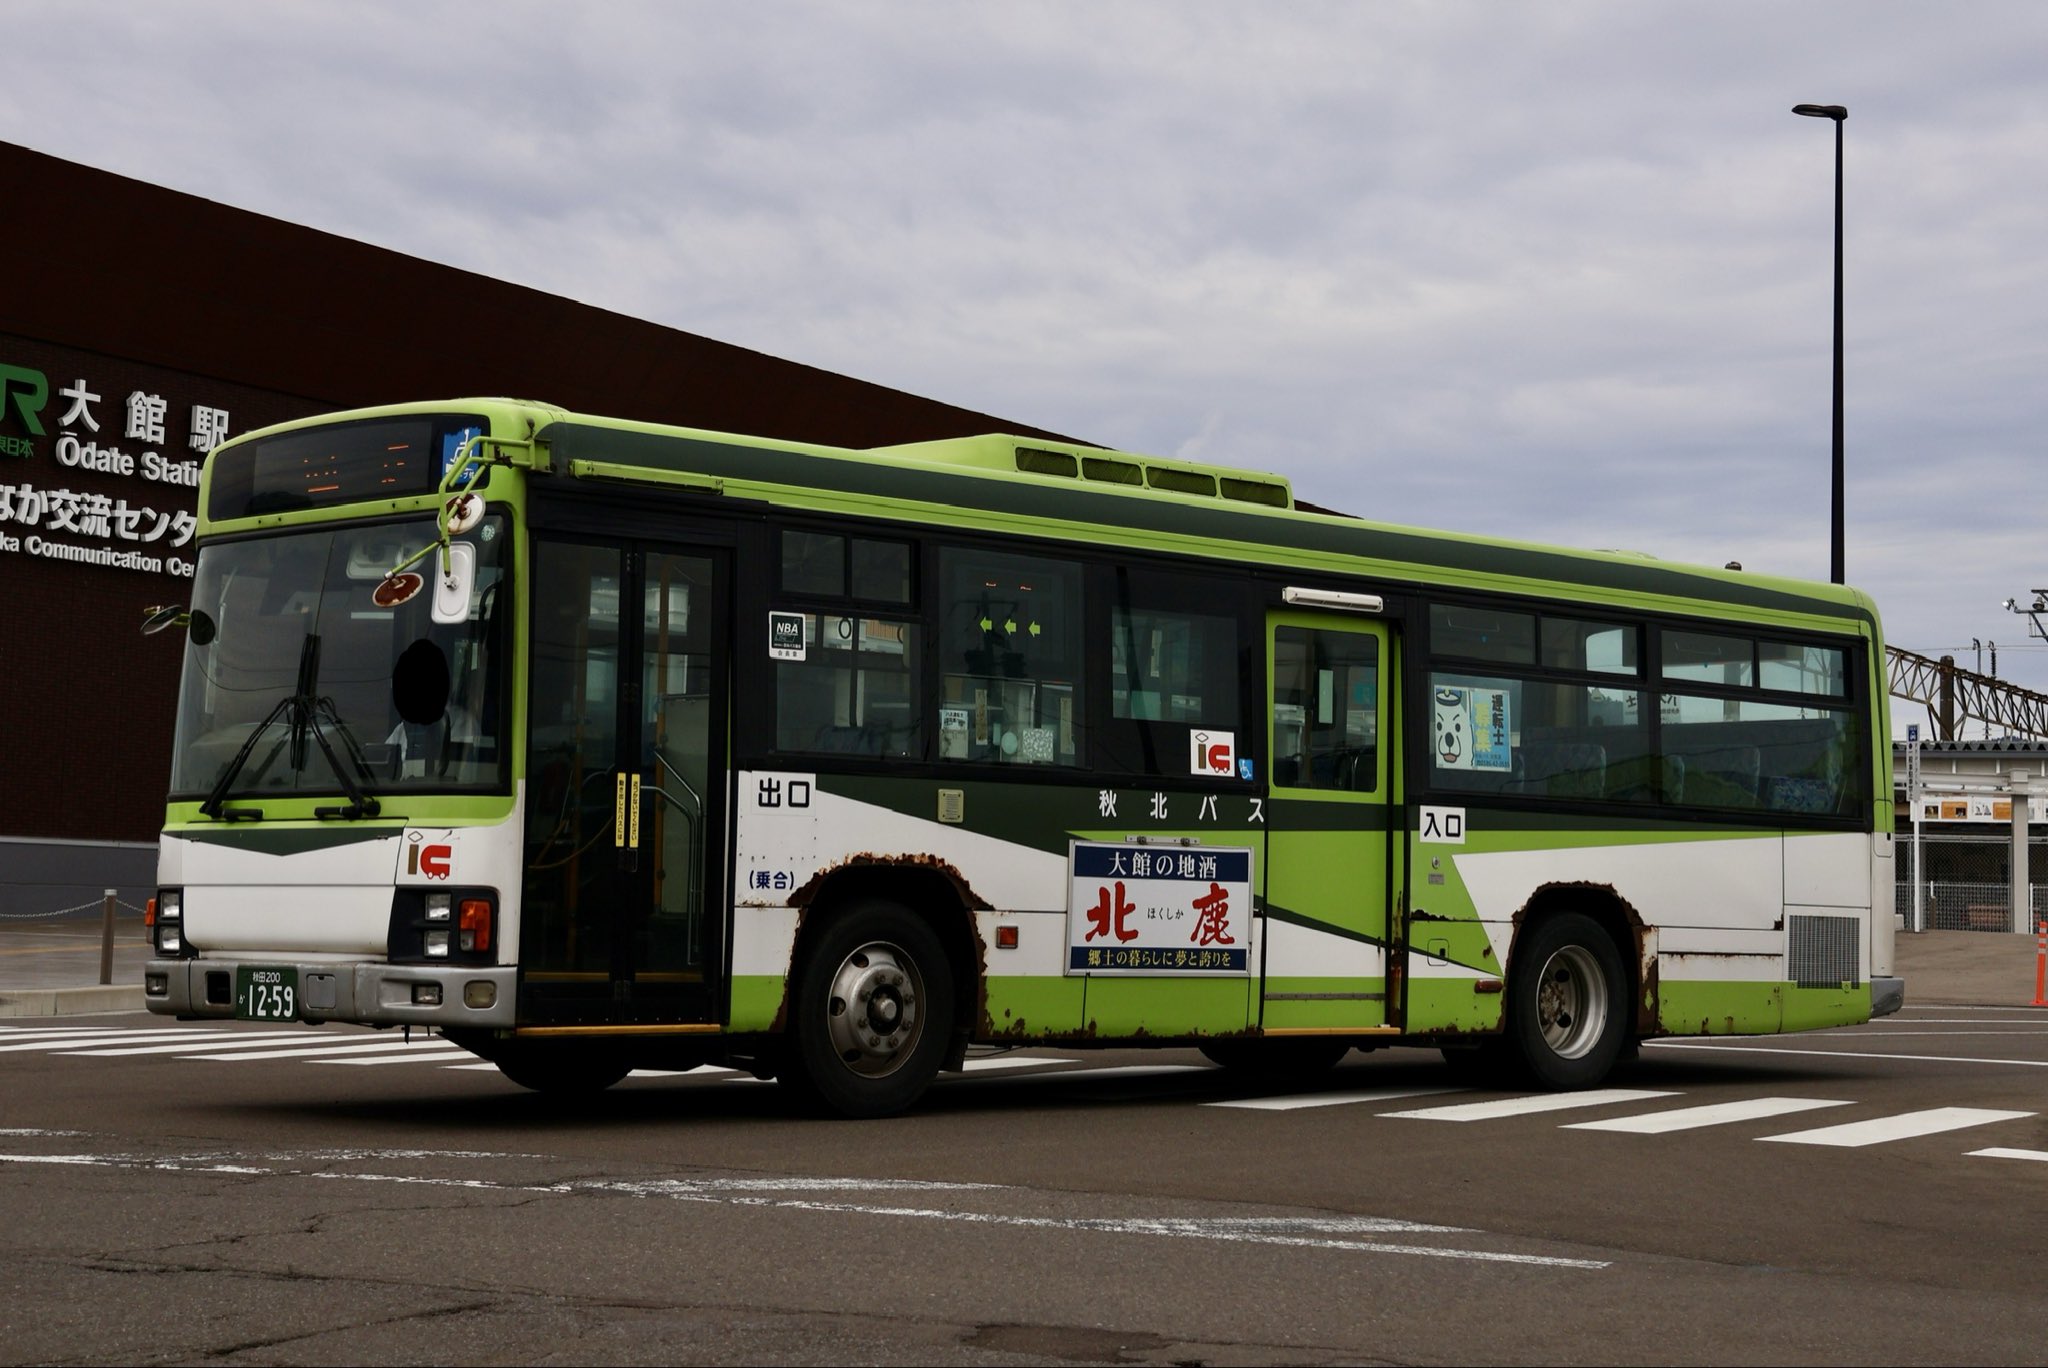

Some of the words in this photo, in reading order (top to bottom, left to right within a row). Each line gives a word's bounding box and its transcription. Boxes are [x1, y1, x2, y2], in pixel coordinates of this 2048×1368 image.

[57, 379, 229, 452] 大館駅
[24, 535, 161, 573] Communication
[776, 622, 798, 635] NBA
[1491, 694, 1504, 746] 運転士
[758, 777, 810, 808] 出口
[1099, 790, 1264, 822] 秋北バス
[1424, 812, 1461, 837] 入口
[1108, 851, 1217, 880] 大館の地酒
[1085, 881, 1139, 944] 北
[1147, 907, 1184, 920] ほくしか
[1087, 949, 1231, 968] 郷土の暮らしに夢と誇りを
